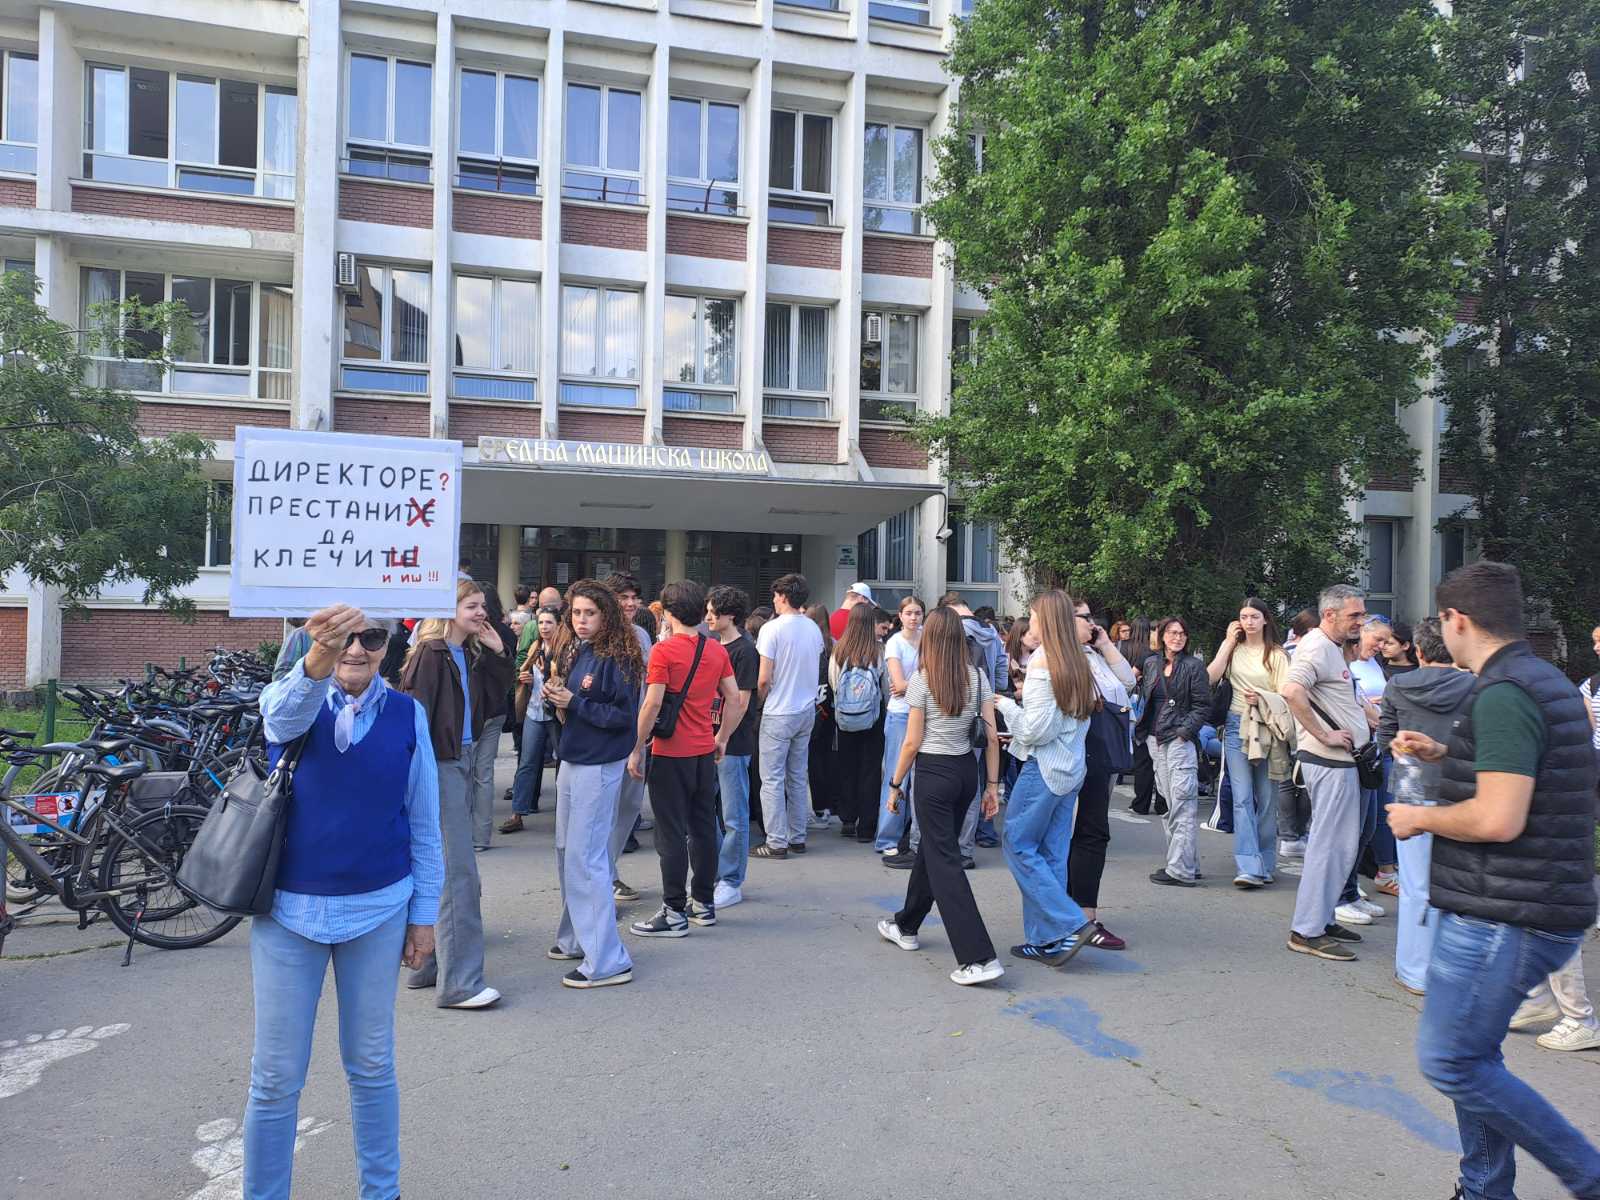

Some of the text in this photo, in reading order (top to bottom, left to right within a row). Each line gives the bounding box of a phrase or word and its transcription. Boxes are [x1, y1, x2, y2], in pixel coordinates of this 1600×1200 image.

[576, 442, 692, 468] МАШИНСКА
[700, 447, 769, 472] ШКОЛА
[318, 529, 355, 545] ДА
